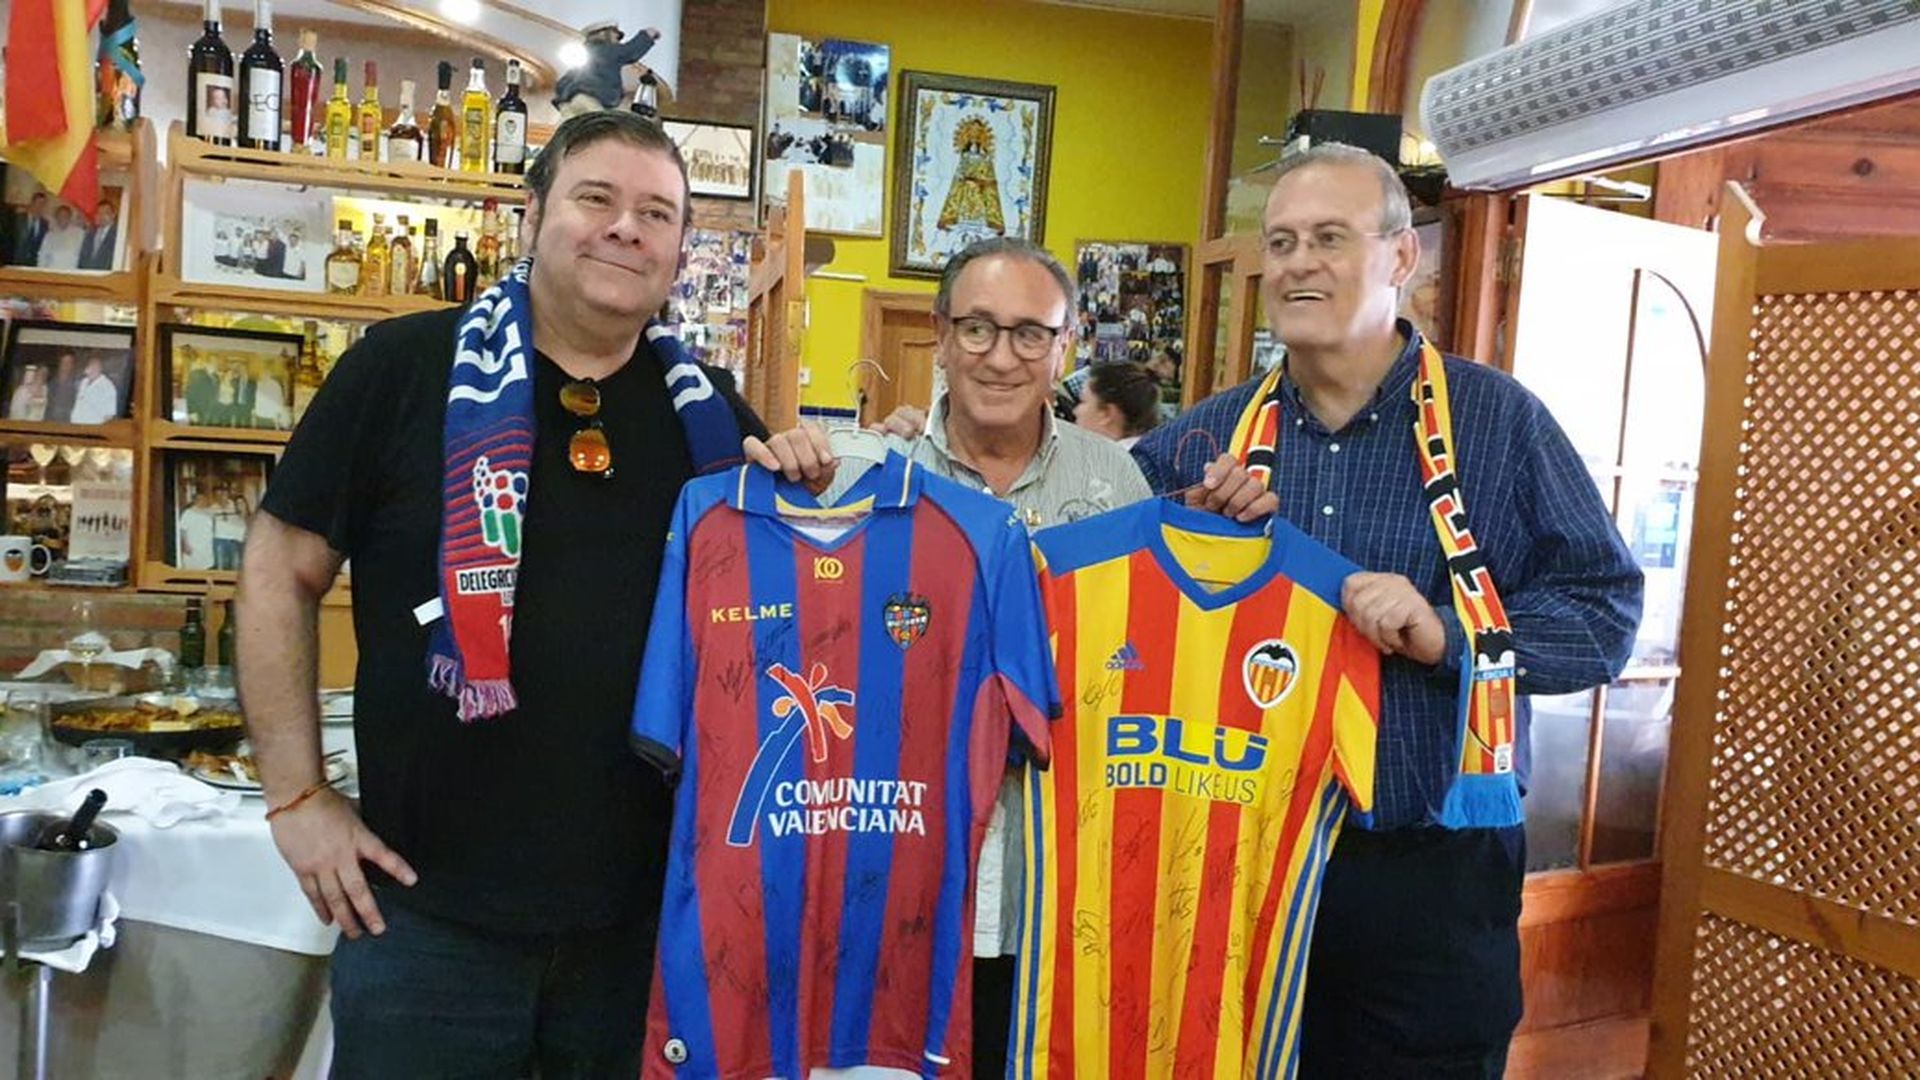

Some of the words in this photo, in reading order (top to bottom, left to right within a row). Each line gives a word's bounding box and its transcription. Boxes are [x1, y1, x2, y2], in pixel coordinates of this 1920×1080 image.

[711, 604, 793, 623] KELME
[1106, 761, 1167, 788] BOLD
[774, 778, 928, 807] COMUNITAT
[768, 806, 926, 837] VALENCIANA
